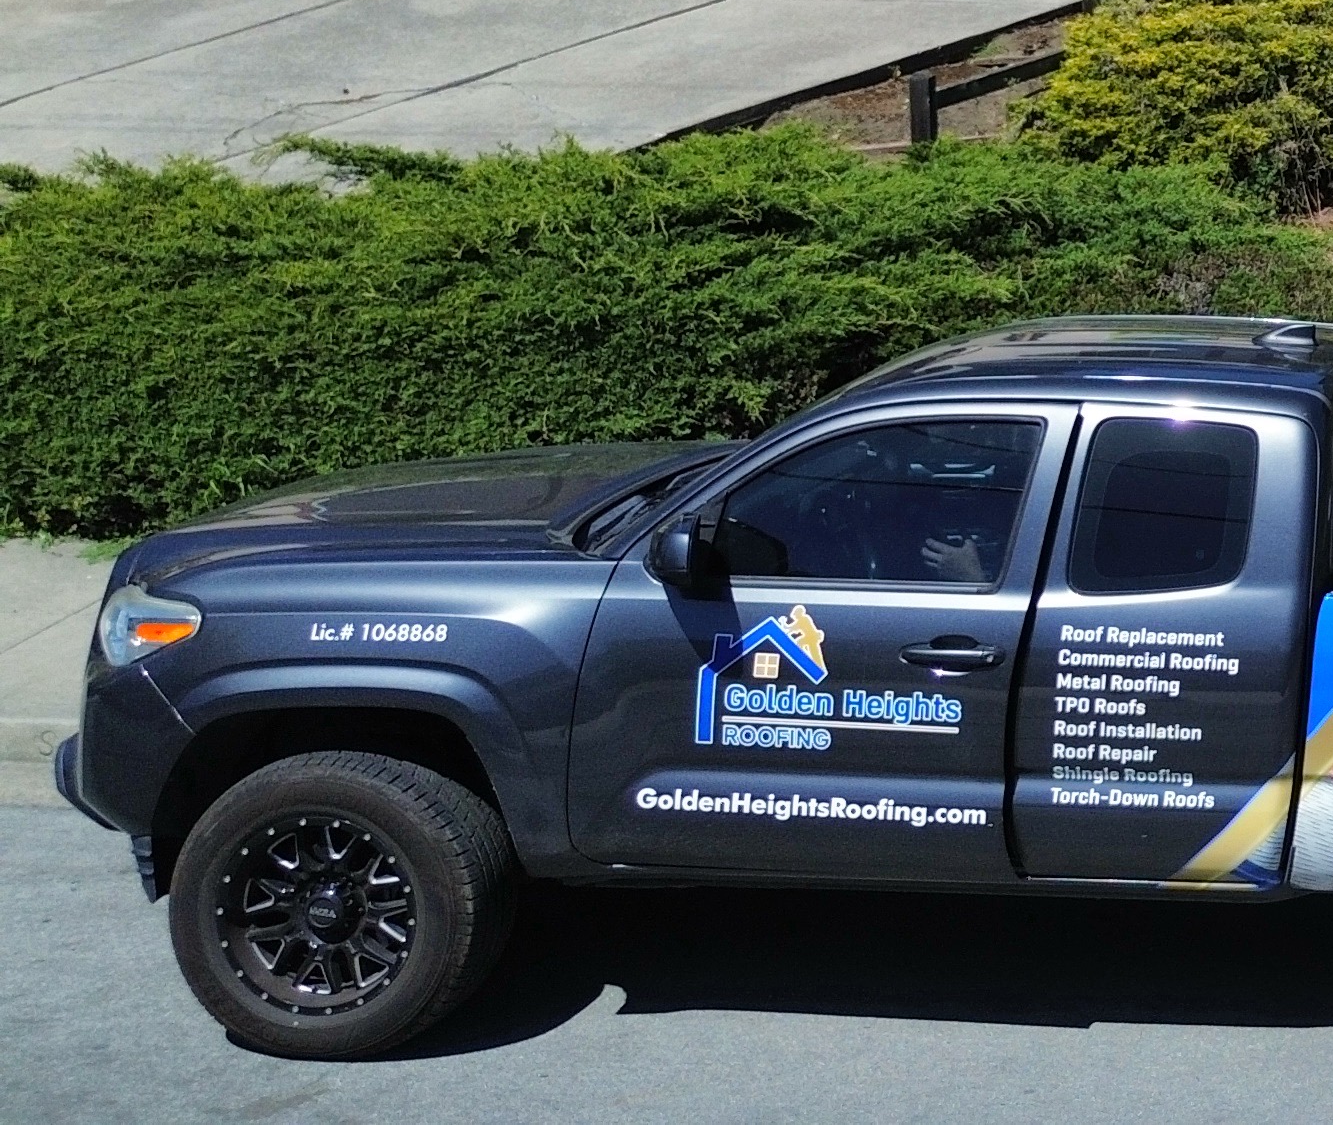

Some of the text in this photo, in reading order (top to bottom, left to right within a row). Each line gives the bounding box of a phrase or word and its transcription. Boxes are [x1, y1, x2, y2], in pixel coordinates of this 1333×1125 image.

[310, 622, 448, 642] Lic.# 1068868
[1060, 625, 1225, 647] Roof Replacement
[1057, 649, 1240, 675] Commercial Roofing
[1056, 673, 1181, 697] Metal Roofing
[723, 684, 963, 725] Golden Heights
[1054, 696, 1147, 716] TPO Roofs
[721, 725, 832, 751] ROOFING
[1054, 720, 1203, 741] Roof Installation
[1052, 743, 1158, 765] Roof Repair
[1052, 766, 1194, 787] Shingle Roofing
[635, 787, 987, 827] GoldenHeightsRoofing.com
[1051, 787, 1215, 808] Torch-Down Roofs
